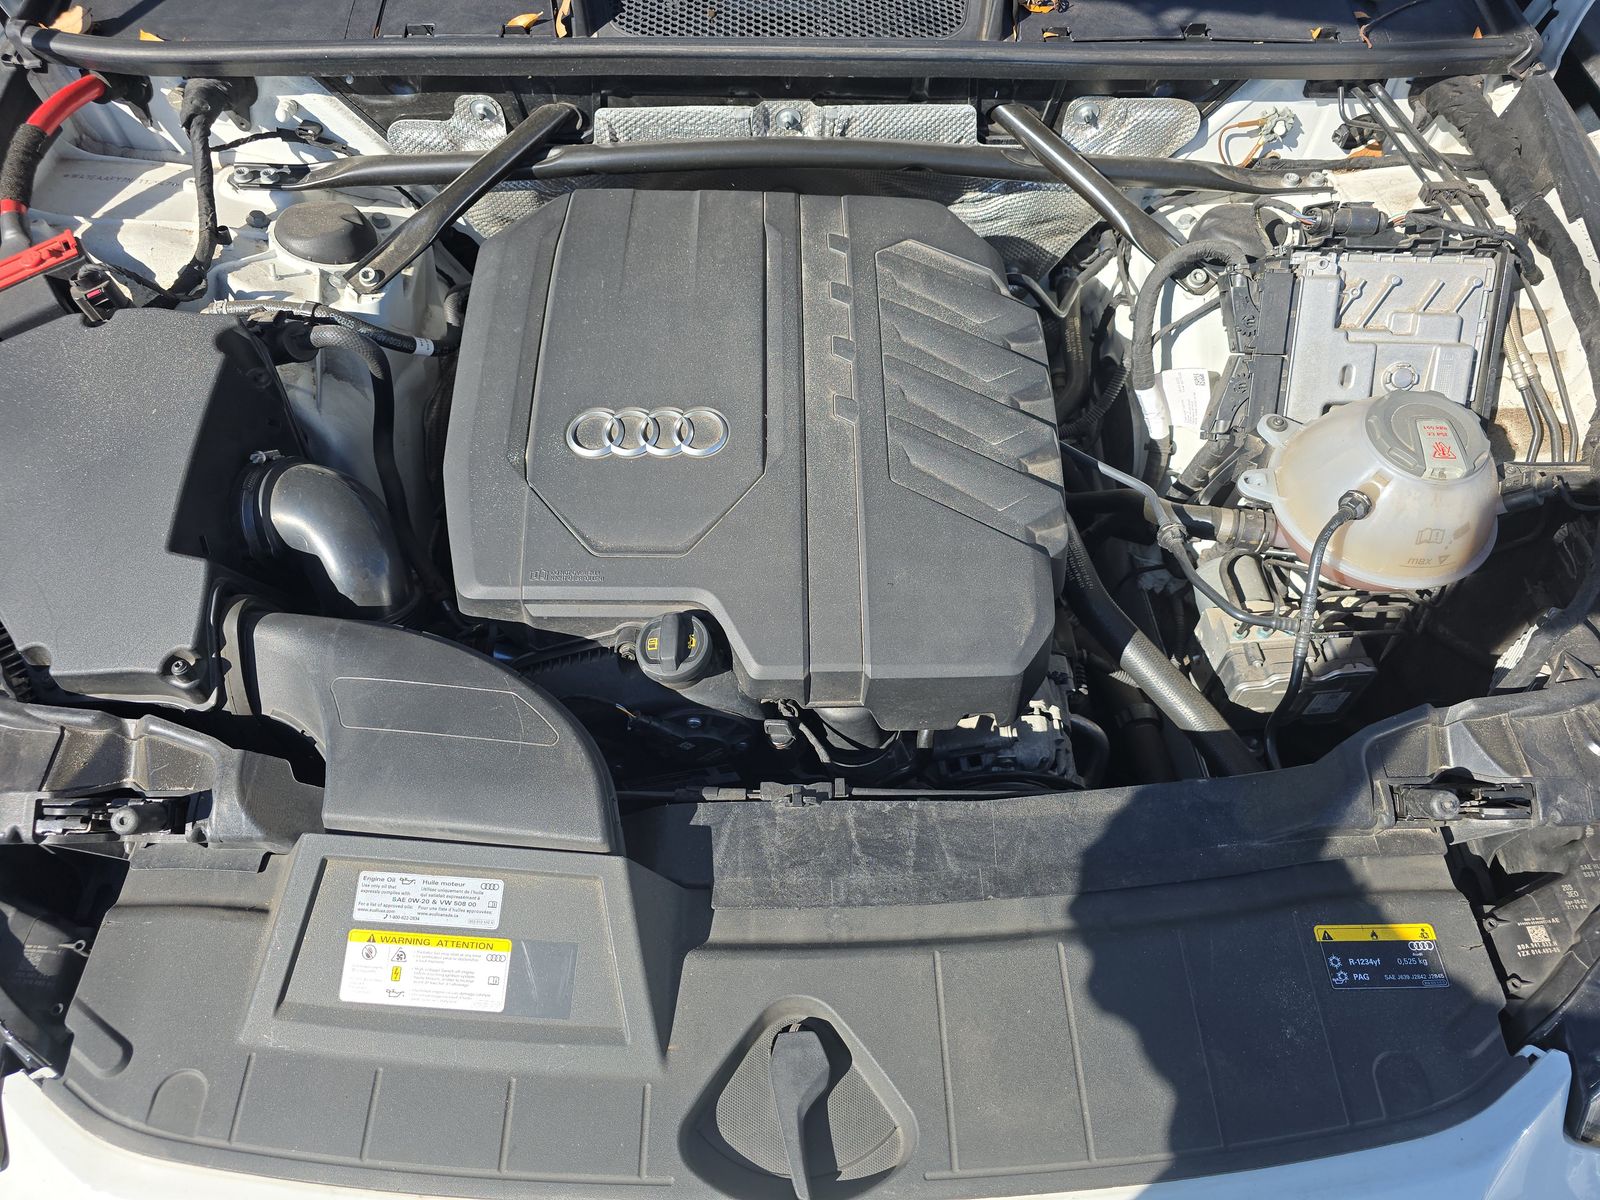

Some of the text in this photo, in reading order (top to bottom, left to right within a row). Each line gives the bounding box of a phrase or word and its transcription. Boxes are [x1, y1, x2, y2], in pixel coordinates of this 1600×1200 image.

[380, 935, 494, 950] WARNING ATTENTION
[1348, 957, 1428, 967] R-1234yf 0,525 kg
[1353, 973, 1370, 981] PAG
